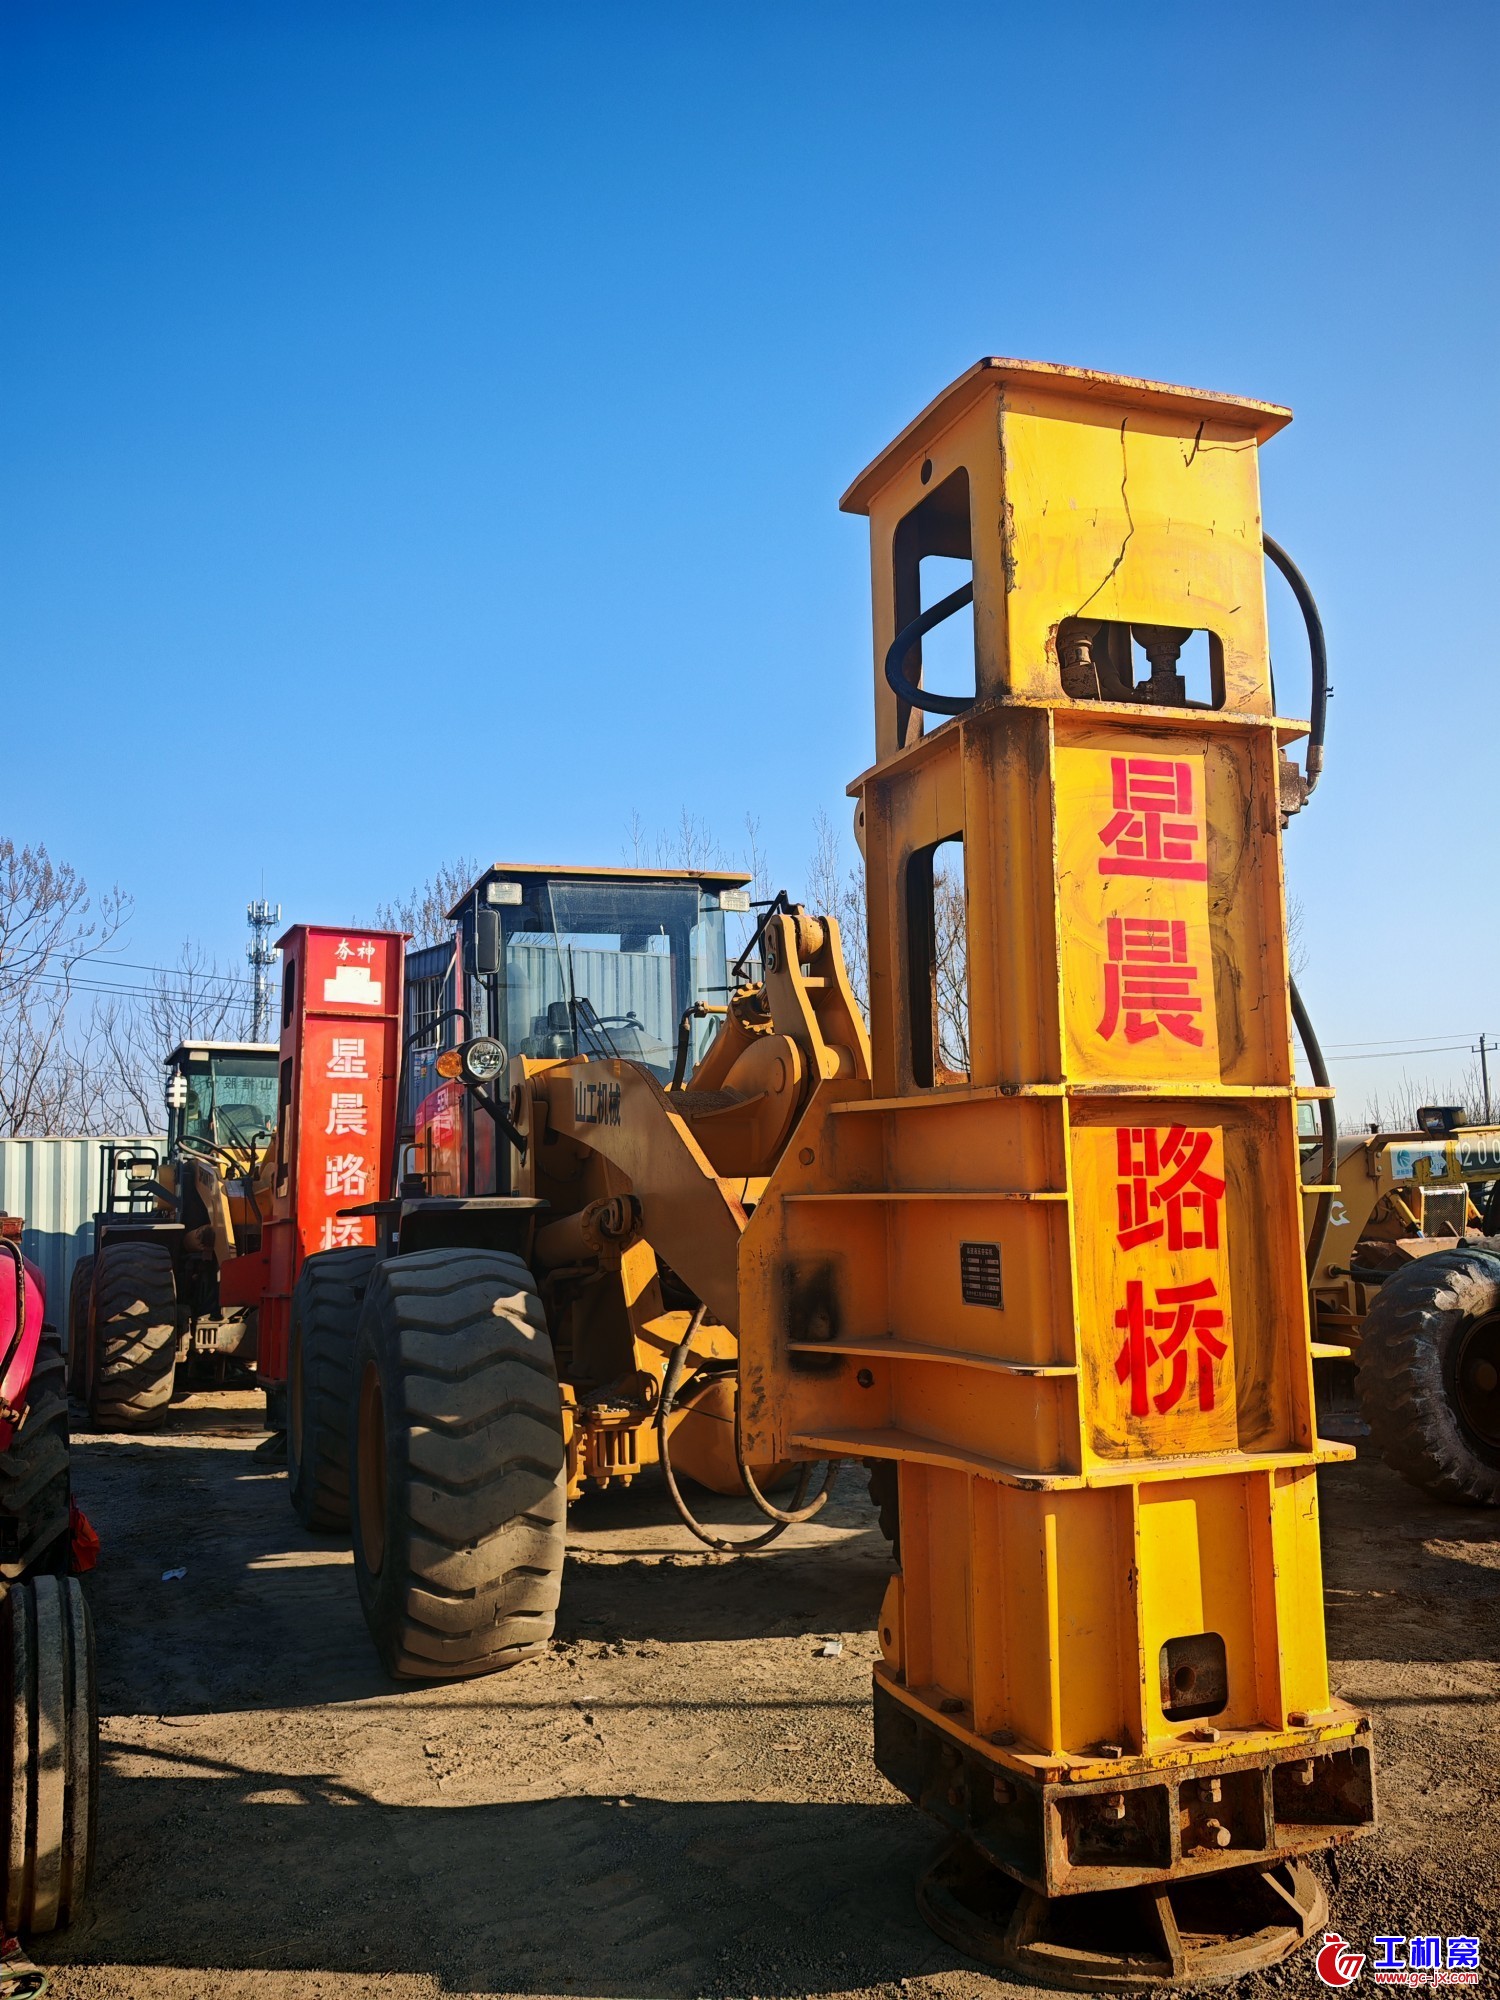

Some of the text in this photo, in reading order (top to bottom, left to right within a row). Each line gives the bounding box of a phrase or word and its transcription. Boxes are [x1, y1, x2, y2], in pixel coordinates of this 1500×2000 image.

[319, 1038, 369, 1248] 星晨路桥
[575, 1081, 621, 1126] 山工机械
[1097, 757, 1228, 1416] 星晨路桥
